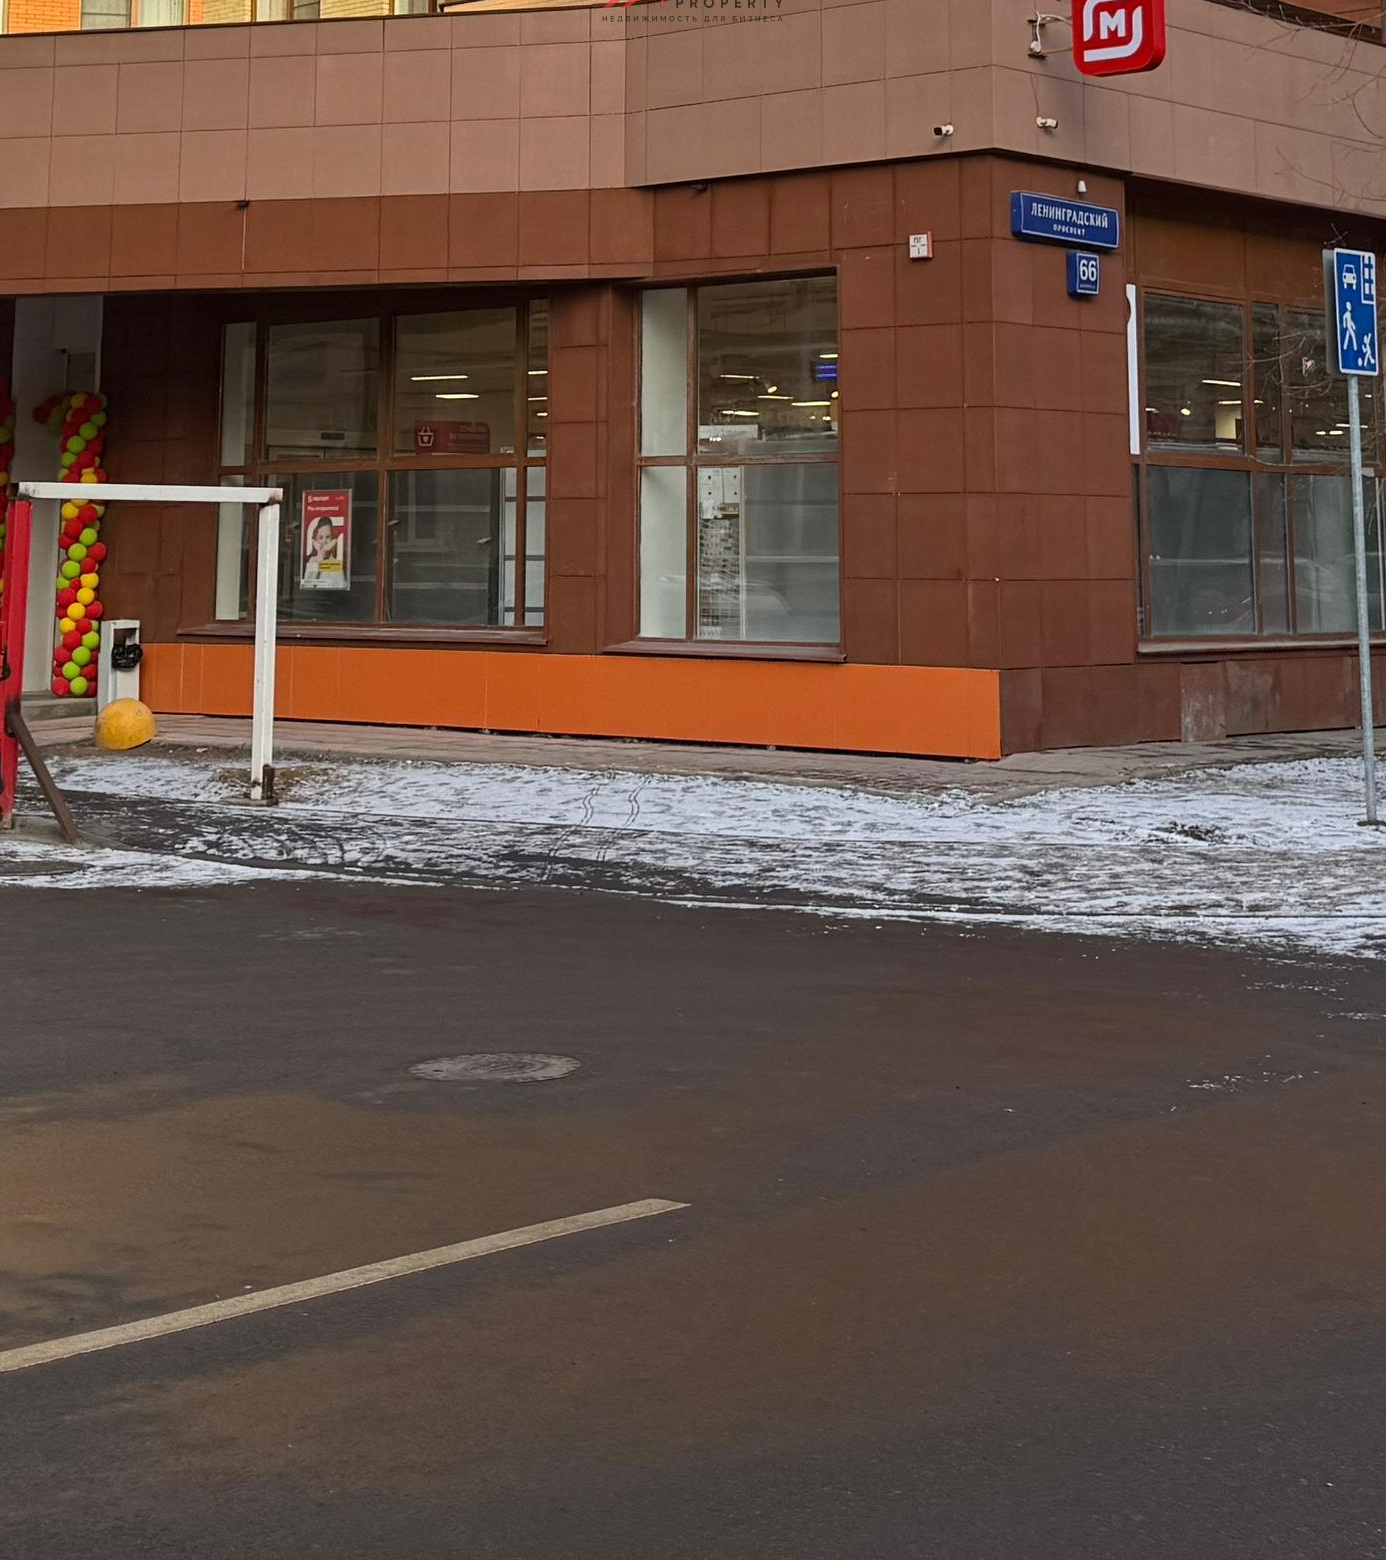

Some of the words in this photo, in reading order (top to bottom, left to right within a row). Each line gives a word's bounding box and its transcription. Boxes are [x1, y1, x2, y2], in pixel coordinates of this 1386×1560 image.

[1031, 202, 1108, 229] ЛЕНИНГРАДСКИЙ
[1053, 223, 1086, 237] ПРОСПЕКТ
[1079, 259, 1097, 282] 66
